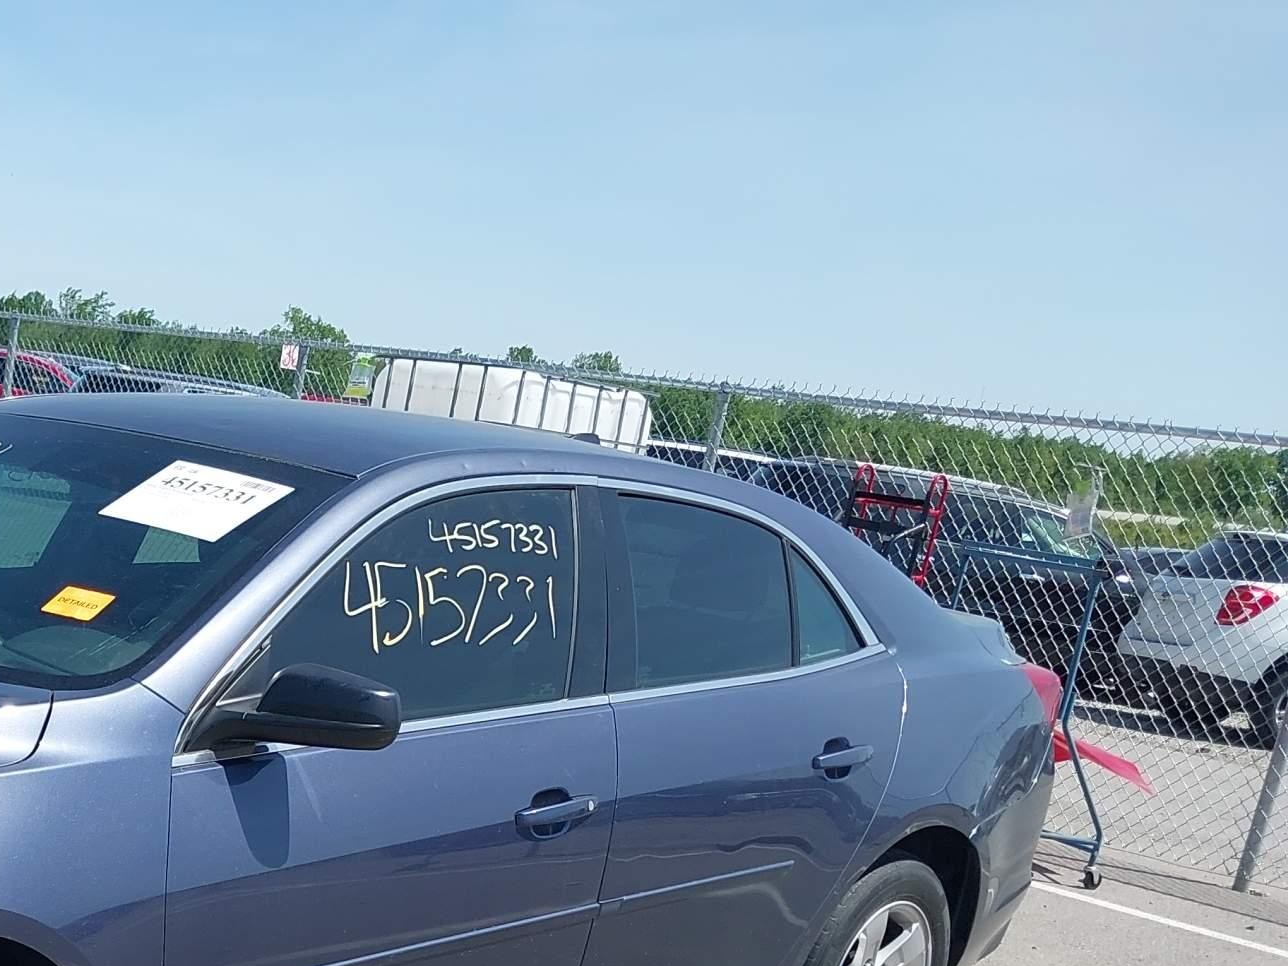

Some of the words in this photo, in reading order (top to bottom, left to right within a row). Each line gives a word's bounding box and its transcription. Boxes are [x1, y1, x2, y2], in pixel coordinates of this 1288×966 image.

[161, 476, 257, 505] 45157331
[428, 518, 558, 559] 45157331
[57, 596, 99, 610] DETAILED
[344, 561, 556, 654] 45157331
